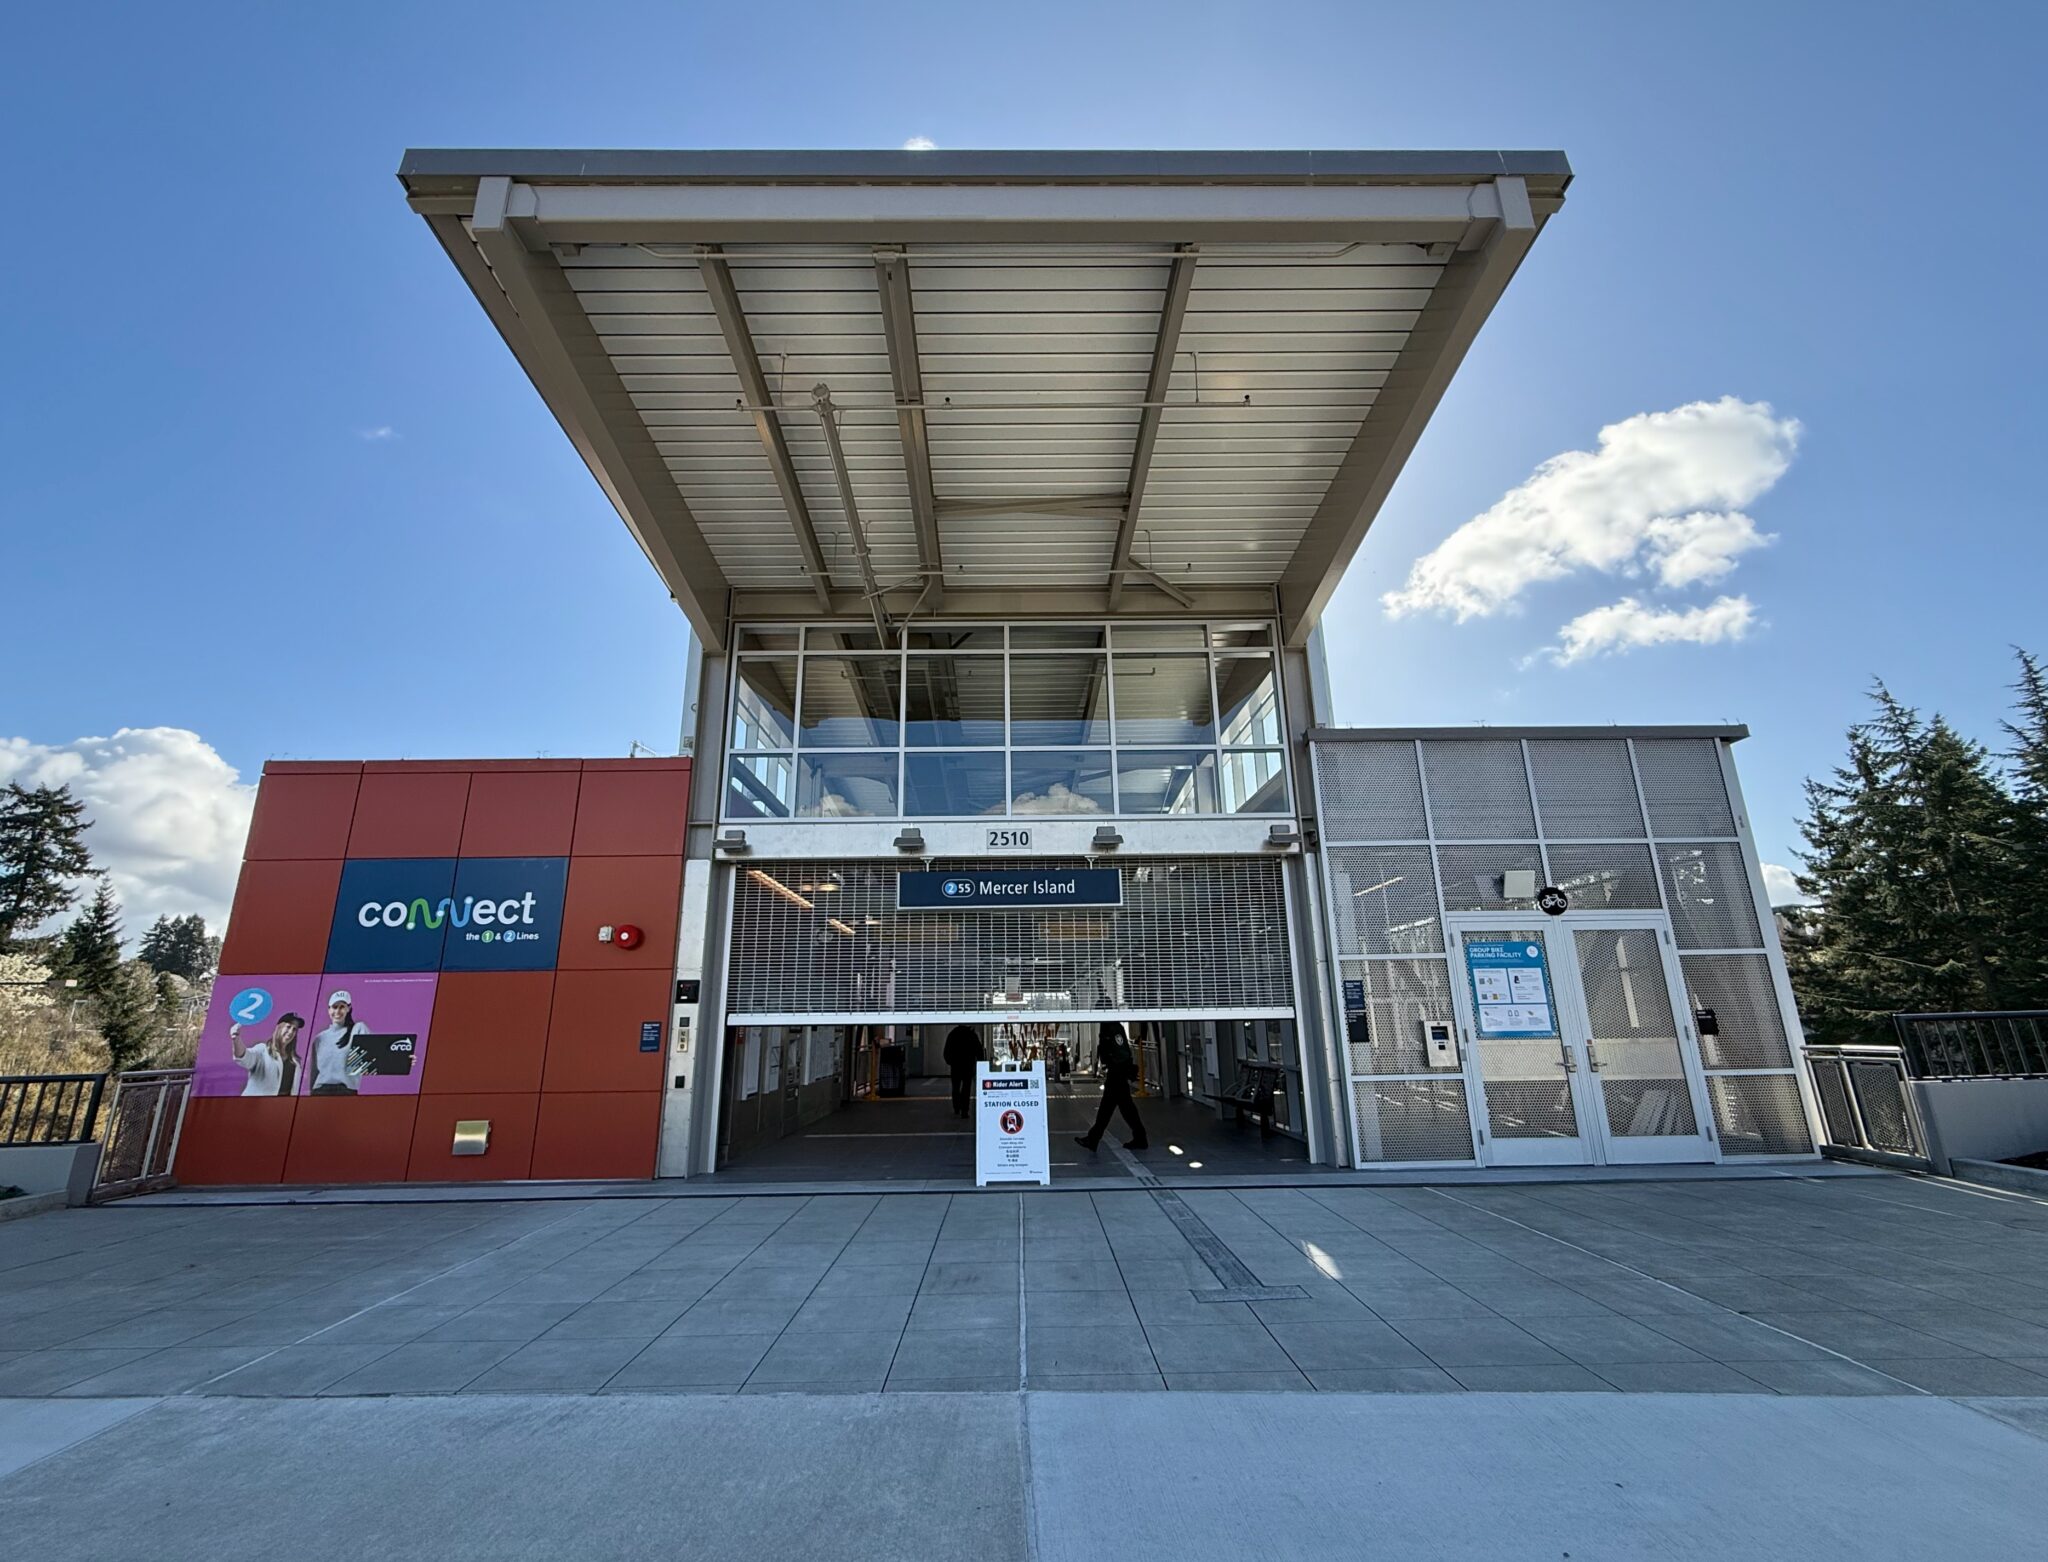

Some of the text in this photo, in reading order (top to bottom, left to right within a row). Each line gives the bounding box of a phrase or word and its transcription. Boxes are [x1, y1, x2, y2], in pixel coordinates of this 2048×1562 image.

[989, 831, 1029, 846] 2510
[948, 879, 1075, 895] 2 55 Mercer Island
[358, 891, 536, 930] connect
[466, 932, 480, 941] the
[494, 932, 501, 940] &
[516, 931, 540, 940] Lines
[237, 992, 264, 1020] 2
[390, 1041, 412, 1051] orca
[992, 1080, 1024, 1088] Rider Alert
